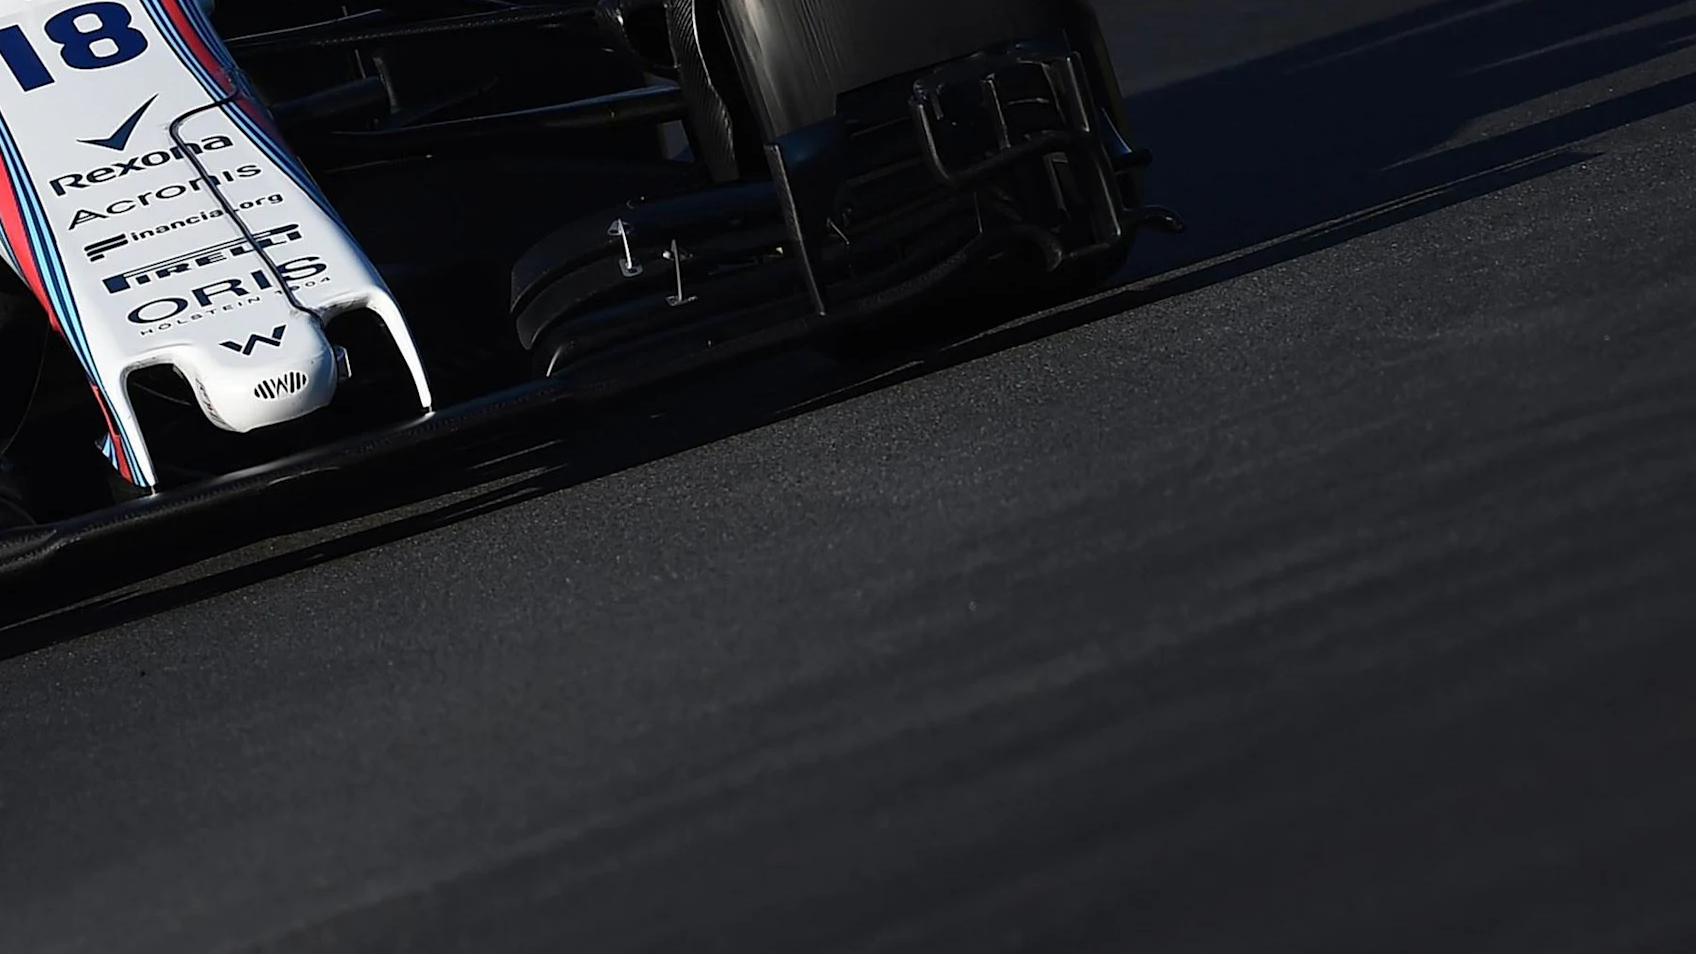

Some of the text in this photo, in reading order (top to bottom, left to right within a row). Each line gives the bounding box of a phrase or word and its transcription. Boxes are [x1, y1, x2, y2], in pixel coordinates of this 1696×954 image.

[49, 134, 234, 197] Rexona
[68, 164, 262, 230] Acronis
[84, 194, 284, 262] Financia.org
[102, 223, 302, 294] PIRELLI
[127, 256, 327, 325] ORIS
